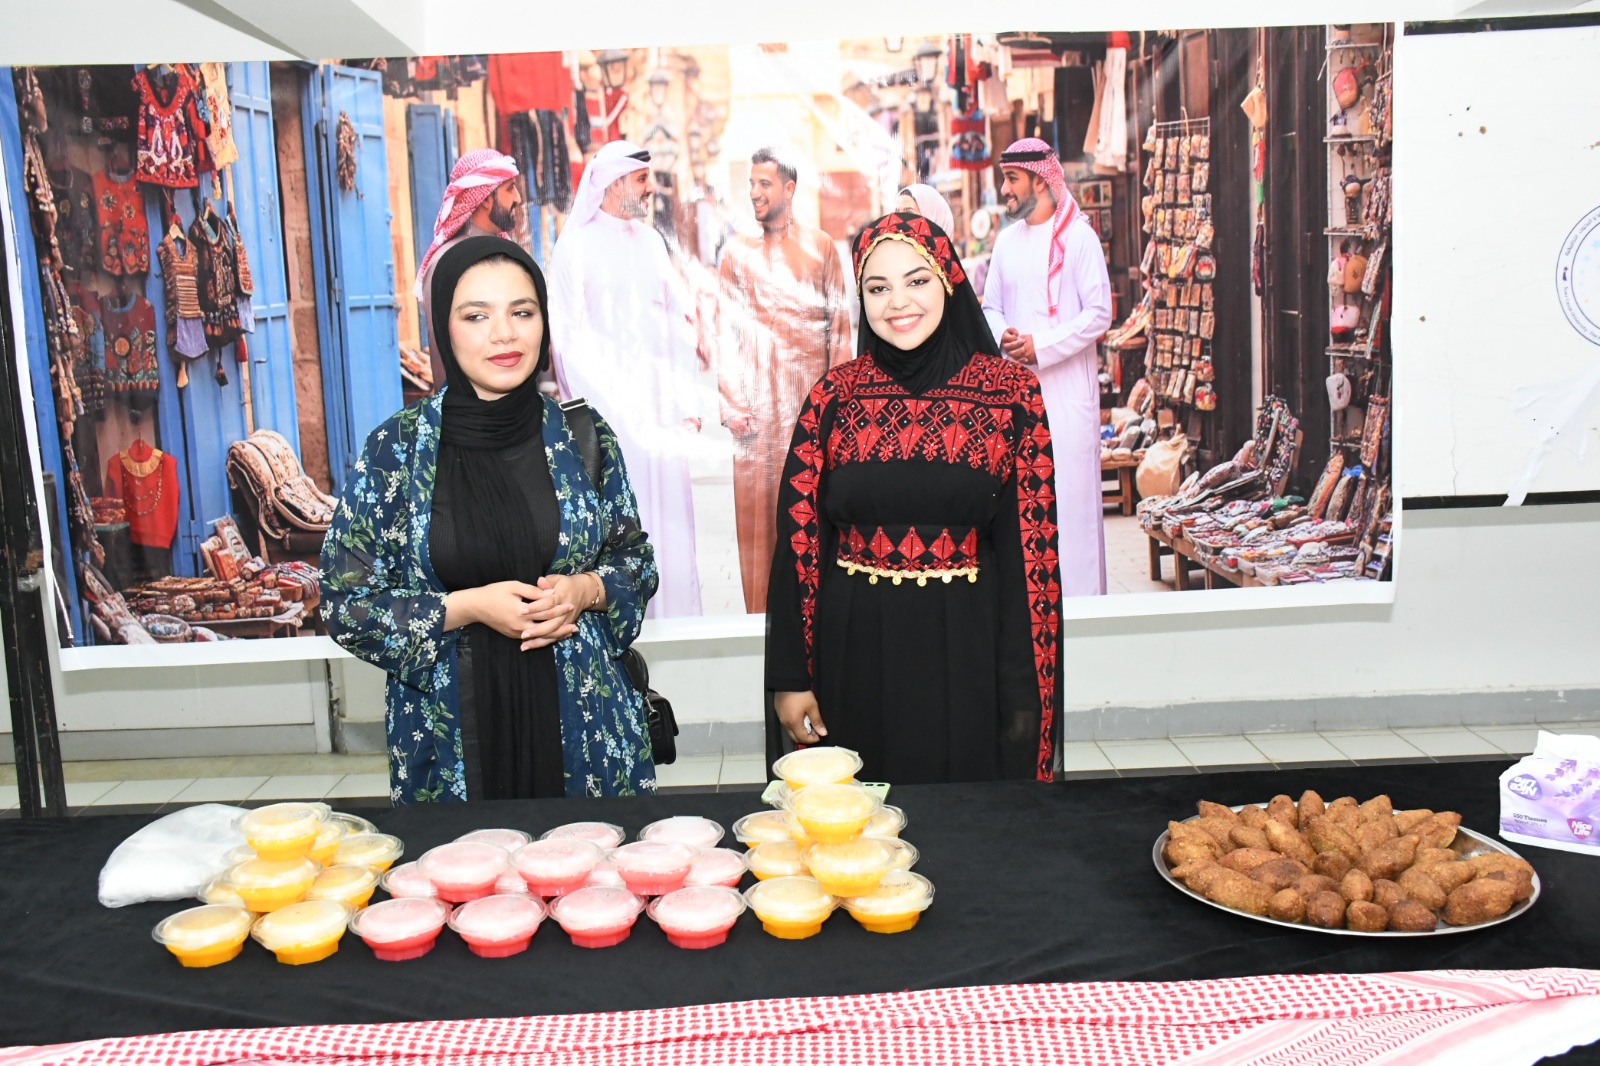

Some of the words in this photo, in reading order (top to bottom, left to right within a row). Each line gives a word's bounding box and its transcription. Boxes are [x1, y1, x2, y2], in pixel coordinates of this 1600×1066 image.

[1570, 311, 1588, 333] University
[1513, 776, 1537, 788] Life
[1509, 782, 1538, 797] Nice
[1523, 814, 1548, 824] Tissues
[1571, 820, 1592, 831] Nice
[1573, 827, 1591, 837] Life
